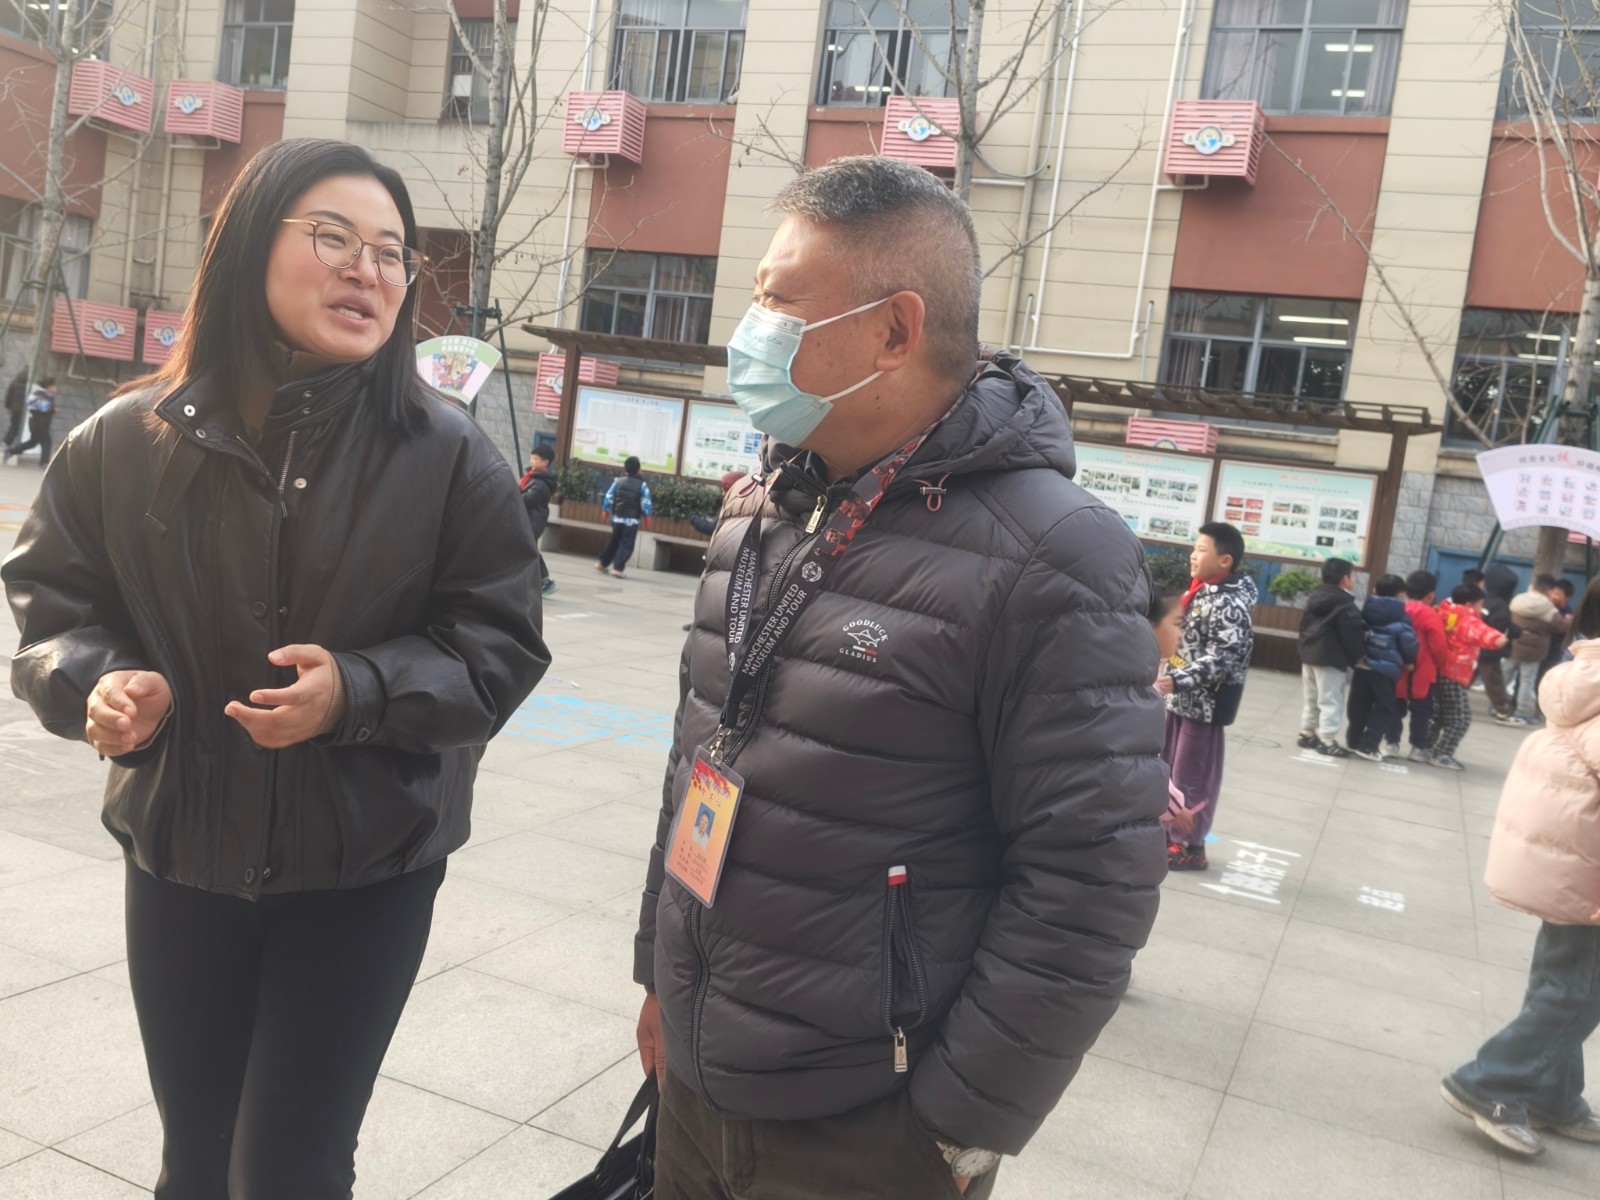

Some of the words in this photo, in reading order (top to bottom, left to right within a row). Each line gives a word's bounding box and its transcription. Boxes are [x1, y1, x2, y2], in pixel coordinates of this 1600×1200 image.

[733, 547, 750, 590] MUSEUM
[740, 551, 757, 608] MANCHESTER
[730, 592, 741, 614] AND
[728, 617, 738, 644] TOUR
[734, 610, 748, 644] UNITED
[742, 615, 778, 674] MANCHESTER
[774, 583, 799, 617] UNITED
[748, 638, 777, 677] MUSEUM
[774, 616, 790, 639] AND
[786, 589, 808, 617] TOUR
[842, 619, 889, 642] GOODLUCK
[839, 648, 877, 663] GLADIUS
